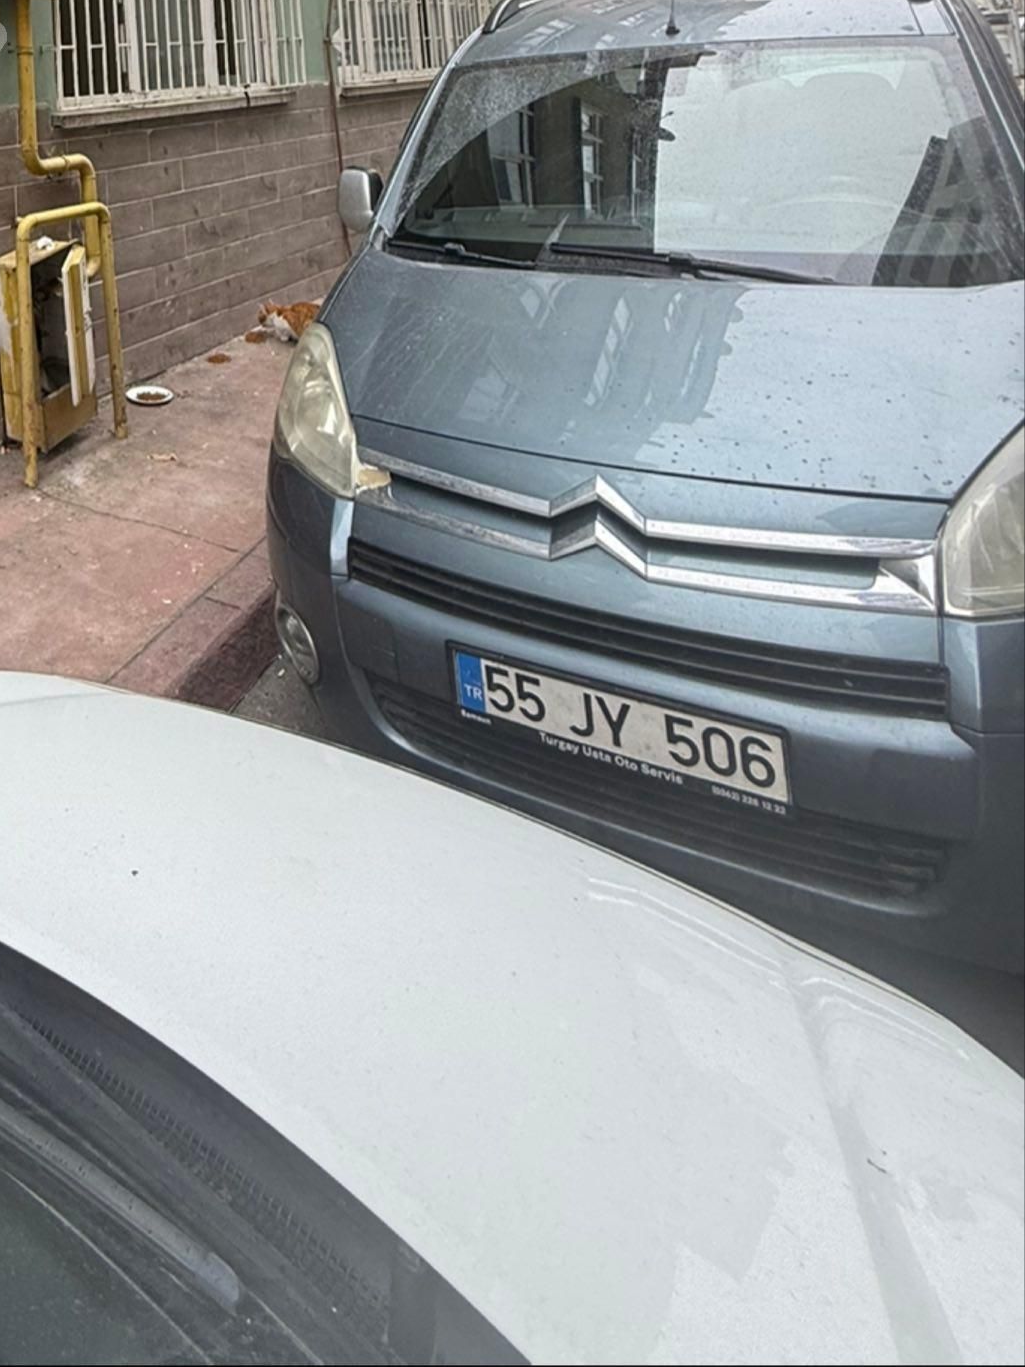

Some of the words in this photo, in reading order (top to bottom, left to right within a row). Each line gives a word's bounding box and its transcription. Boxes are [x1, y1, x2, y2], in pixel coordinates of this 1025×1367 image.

[464, 683, 483, 701] TR
[484, 664, 546, 723] 55
[569, 692, 631, 748] JY
[664, 714, 777, 788] 506
[539, 732, 580, 755] Turgay
[582, 744, 612, 764] Usta
[614, 755, 639, 772] Oto
[641, 762, 684, 785] Servis
